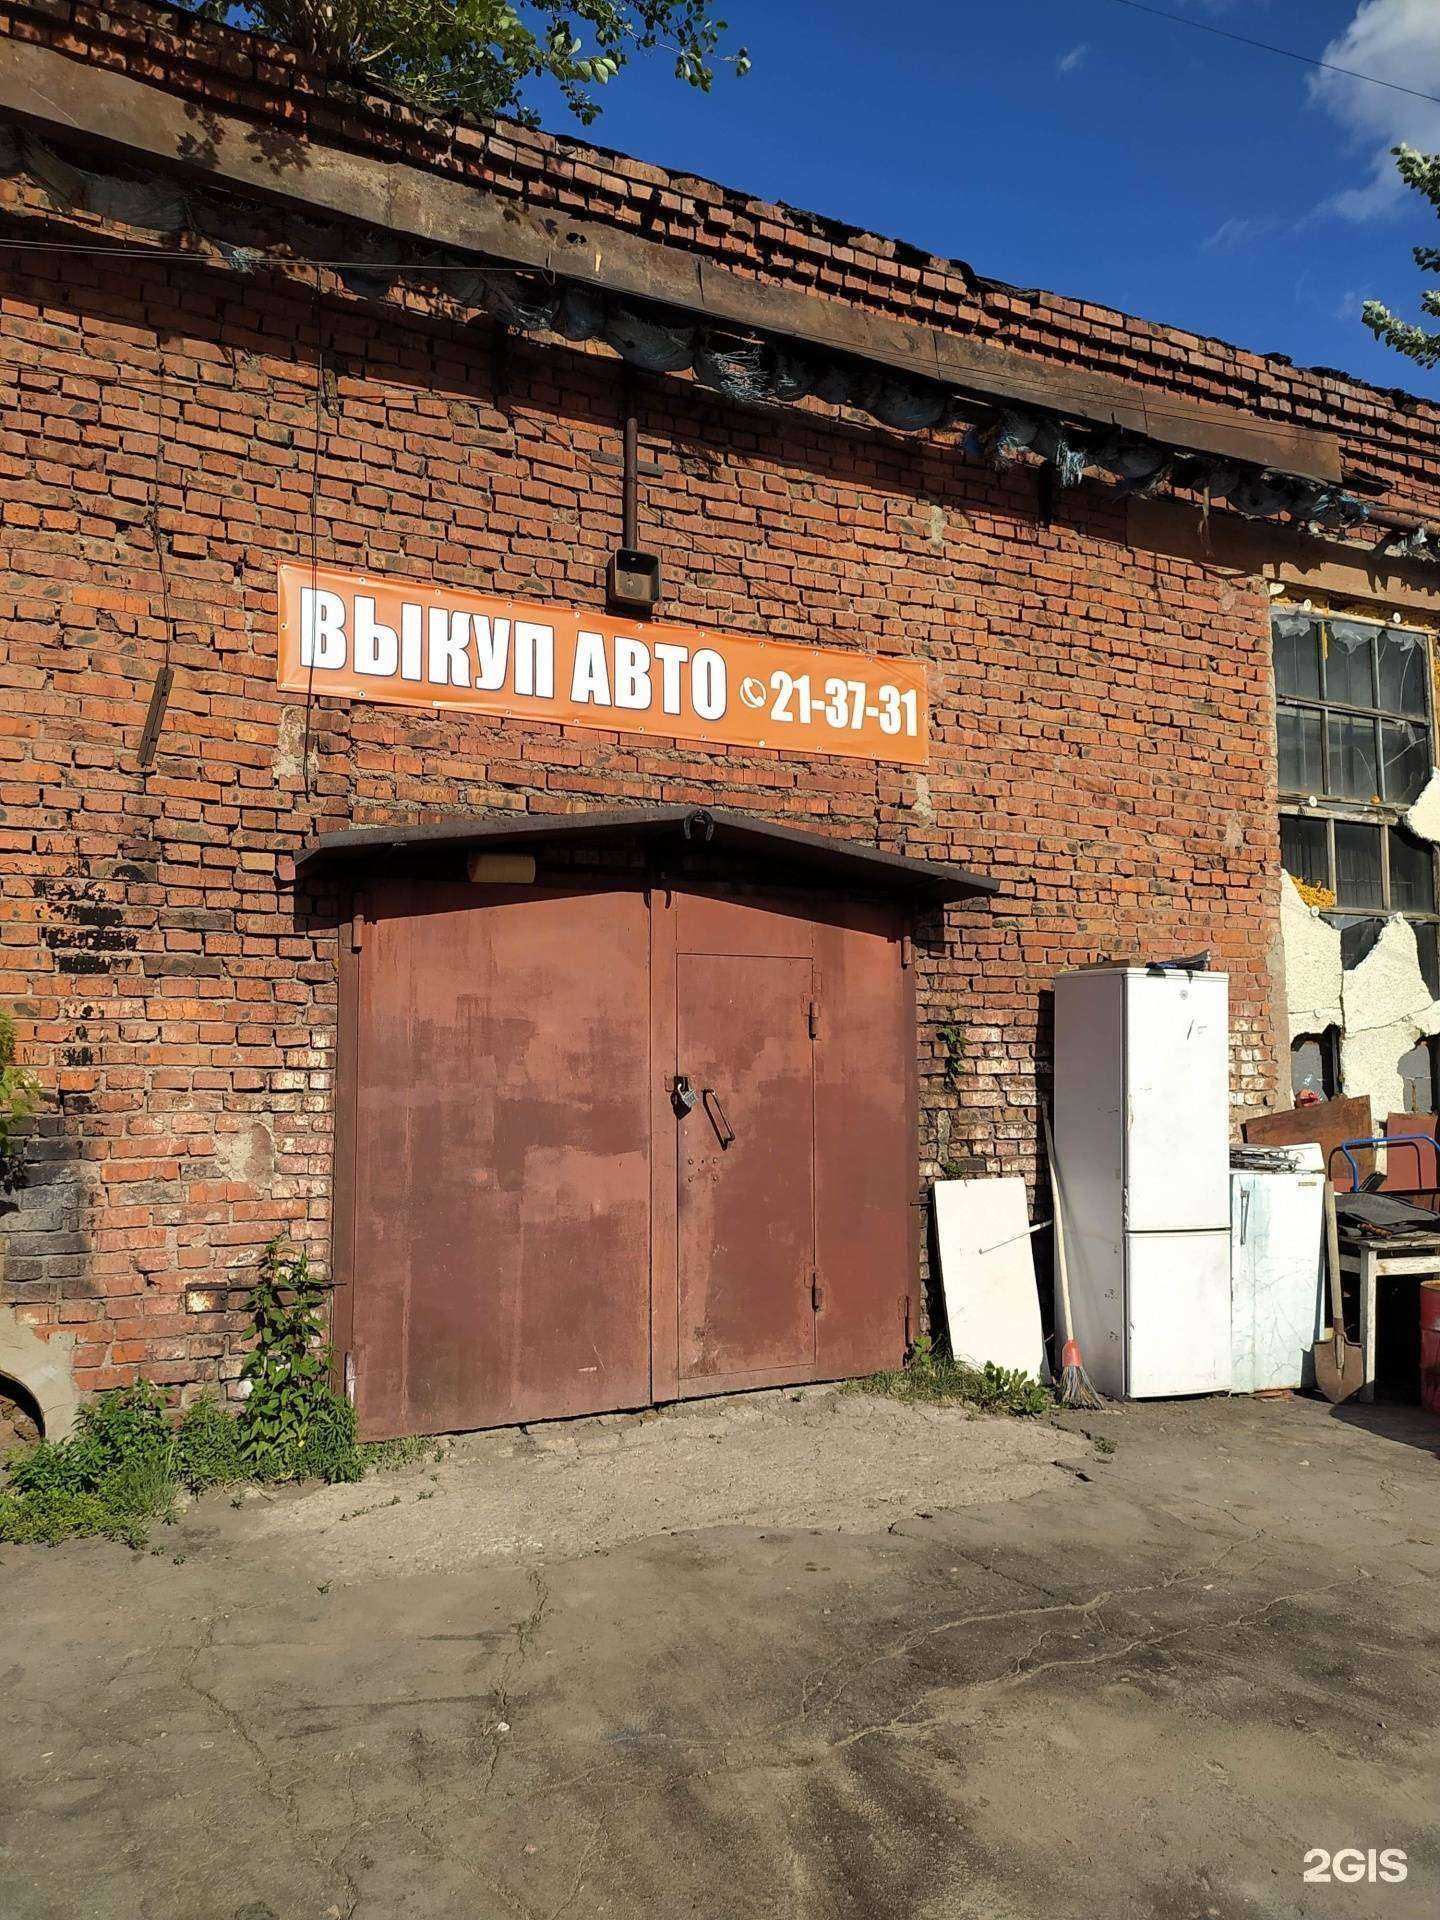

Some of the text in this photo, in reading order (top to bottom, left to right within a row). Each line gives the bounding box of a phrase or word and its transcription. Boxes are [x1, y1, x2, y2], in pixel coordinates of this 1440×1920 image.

[300, 587, 918, 737] ВЫКУП АВТО 21-37-31
